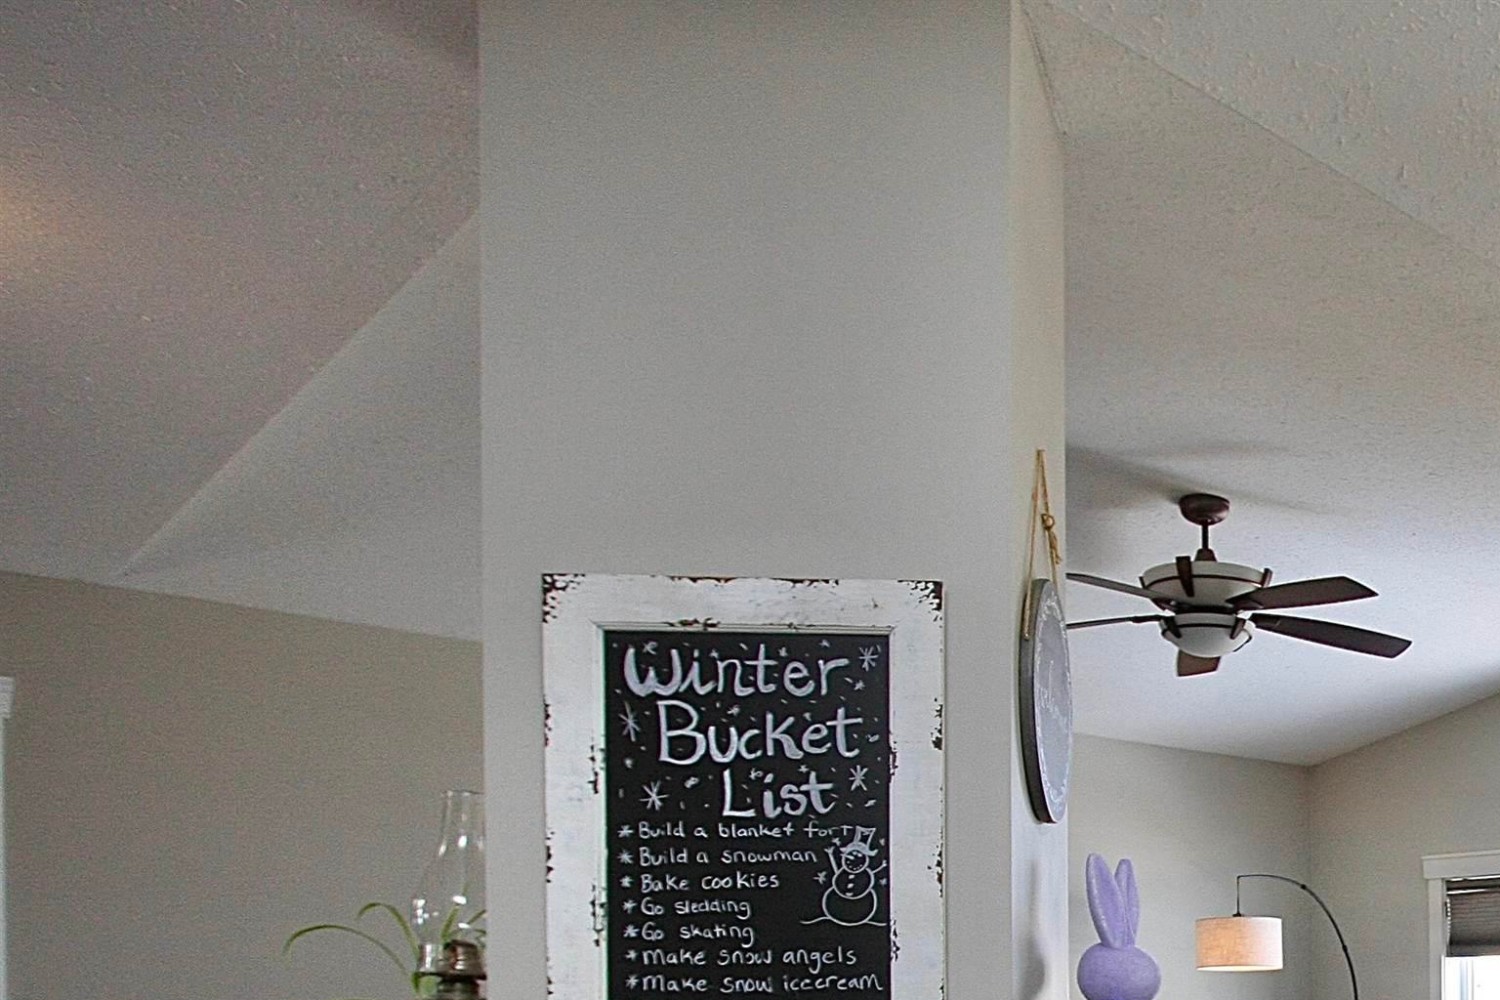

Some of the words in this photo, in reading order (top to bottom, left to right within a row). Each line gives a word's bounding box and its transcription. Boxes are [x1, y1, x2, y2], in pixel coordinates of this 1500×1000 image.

[623, 642, 850, 697] Winter
[657, 700, 864, 766] Bucket
[722, 768, 834, 820] List
[638, 820, 686, 839] Build
[693, 829, 709, 838] a
[718, 821, 795, 838] blanket
[639, 846, 689, 867] Build
[696, 853, 709, 864] a
[720, 850, 818, 863] snowman
[640, 873, 691, 893] Bake
[701, 871, 780, 890] cookies
[640, 896, 665, 916] Go
[674, 900, 751, 920] sledding
[641, 921, 665, 941] Go
[679, 923, 754, 948] skating
[782, 945, 857, 974] angels
[783, 974, 883, 992] icecream
